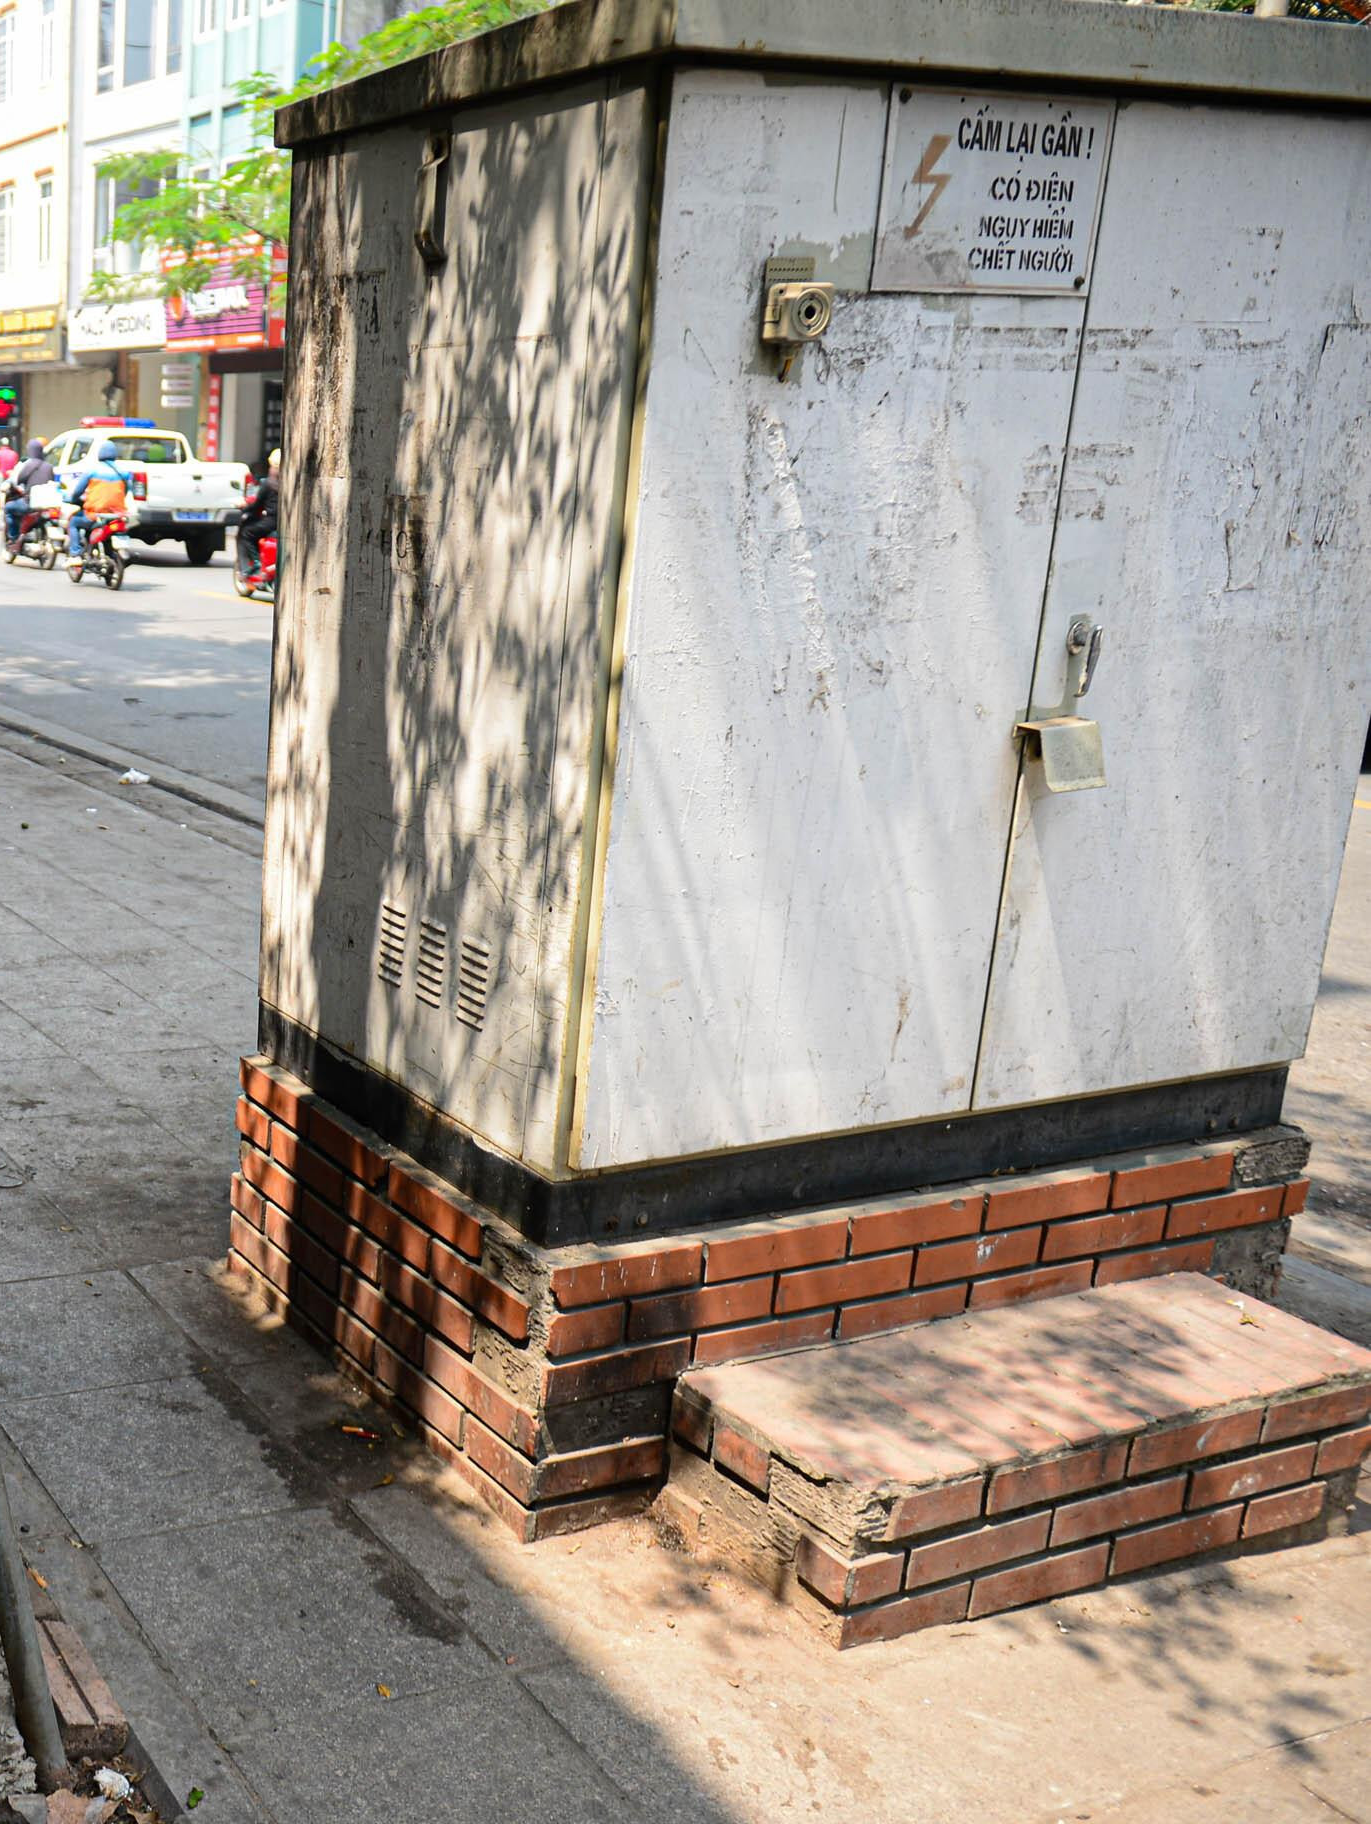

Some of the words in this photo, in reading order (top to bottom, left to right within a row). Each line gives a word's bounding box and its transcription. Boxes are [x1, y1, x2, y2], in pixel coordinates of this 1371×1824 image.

[958, 105, 1002, 152] CẤM
[1006, 121, 1037, 162] LẠI
[1042, 111, 1083, 157] GẦN
[991, 170, 1021, 202] CÓ
[1026, 172, 1074, 208] ĐIỆN
[979, 216, 1031, 239] NGUY
[1032, 206, 1074, 239] HIỂM
[968, 241, 1016, 270] CHẾT
[1018, 244, 1073, 272] NGƯỜI
